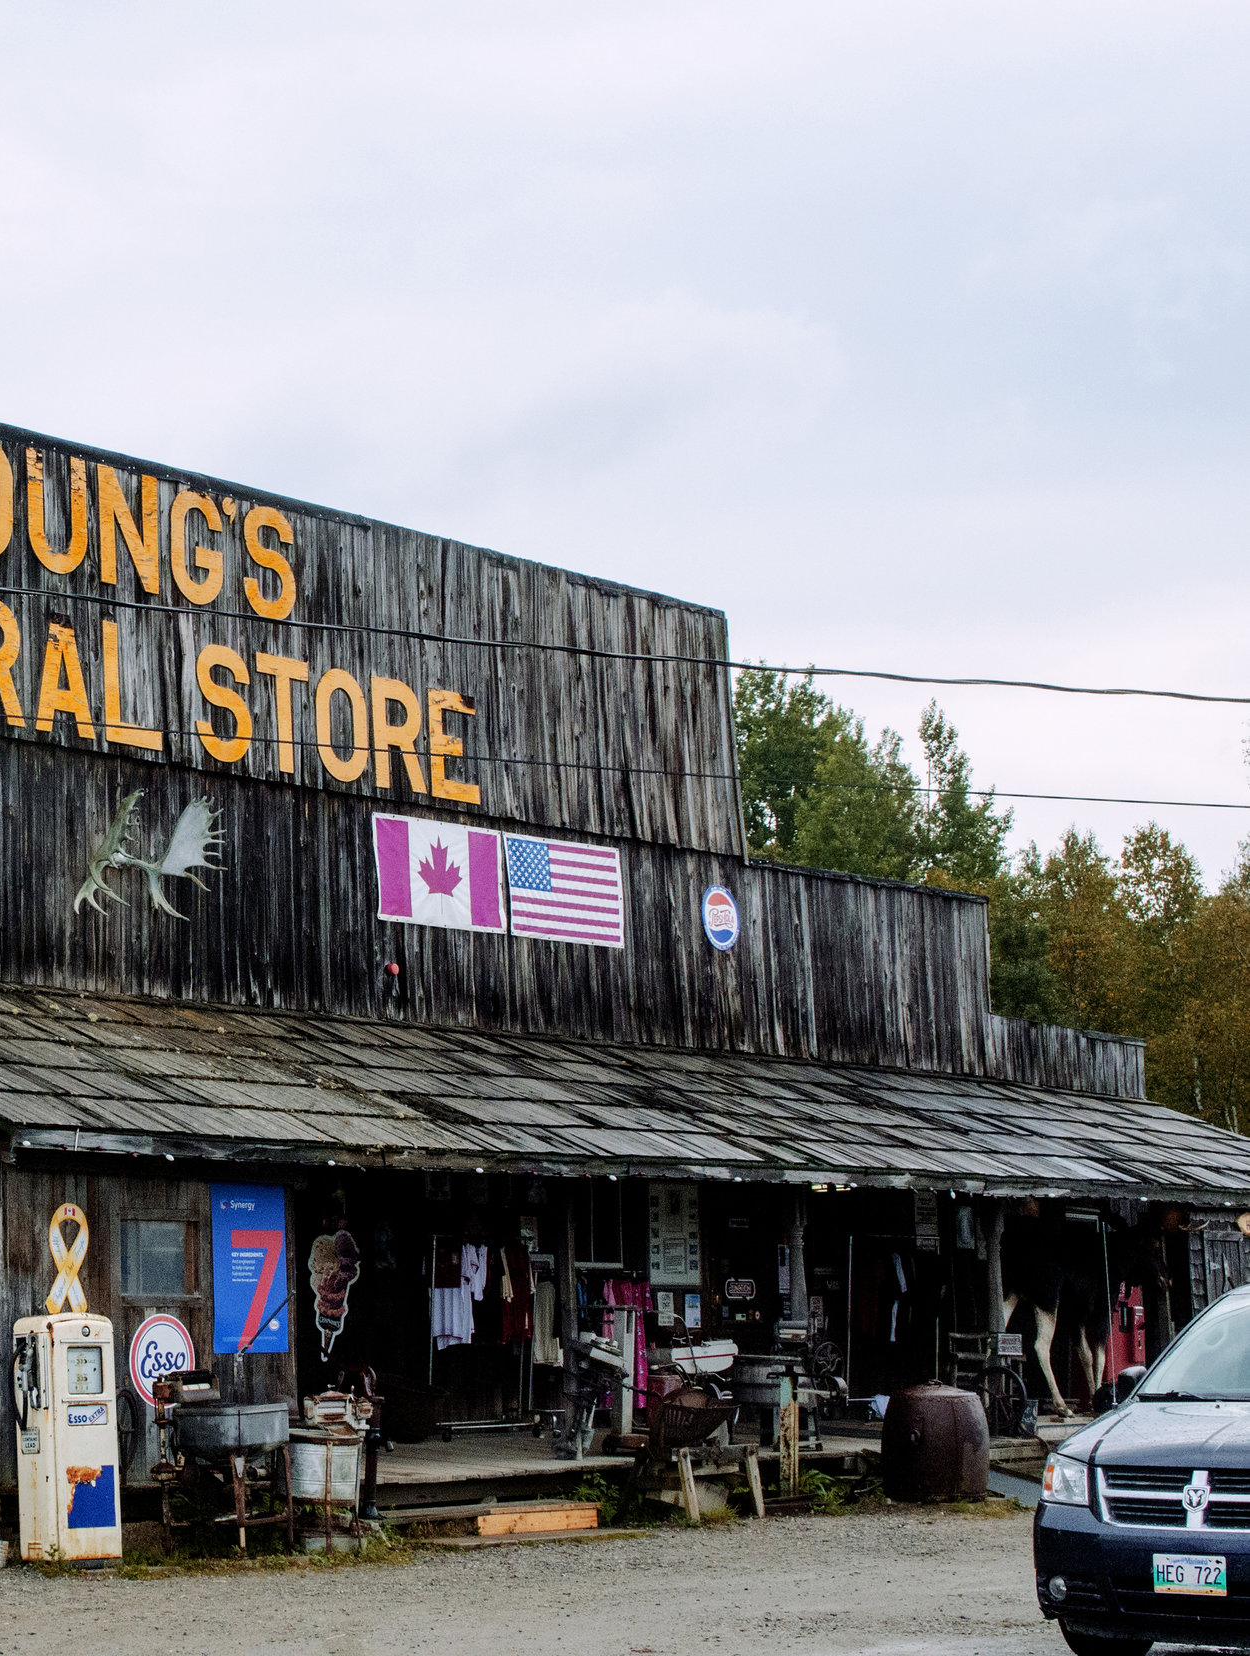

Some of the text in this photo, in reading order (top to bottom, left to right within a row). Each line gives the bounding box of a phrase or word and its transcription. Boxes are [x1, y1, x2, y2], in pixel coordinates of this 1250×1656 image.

[195, 644, 481, 805] STORE
[230, 1200, 255, 1211] Synergy
[231, 1230, 283, 1350] 7
[141, 1341, 186, 1379] Esso
[88, 1406, 105, 1422] EXTRA
[1156, 1564, 1222, 1585] HEG 722
